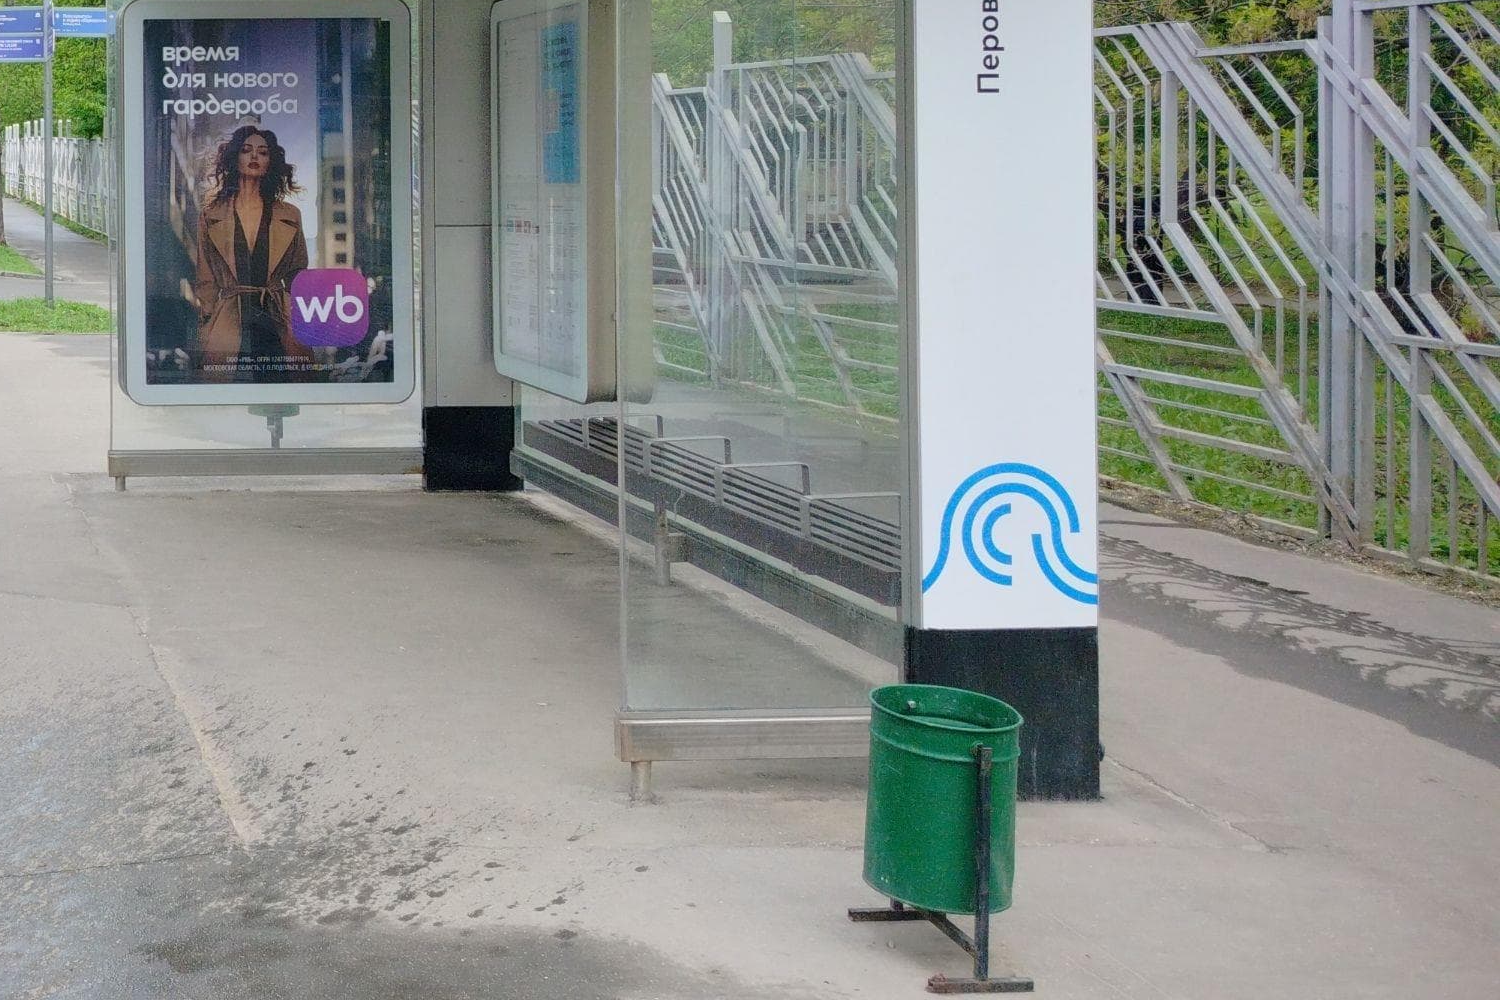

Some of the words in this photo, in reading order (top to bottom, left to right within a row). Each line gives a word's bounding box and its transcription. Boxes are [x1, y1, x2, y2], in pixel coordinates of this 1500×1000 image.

[162, 46, 240, 67] время
[162, 67, 206, 88] для
[214, 72, 299, 88] нового
[162, 93, 298, 120] гардероба
[295, 284, 364, 324] wb
